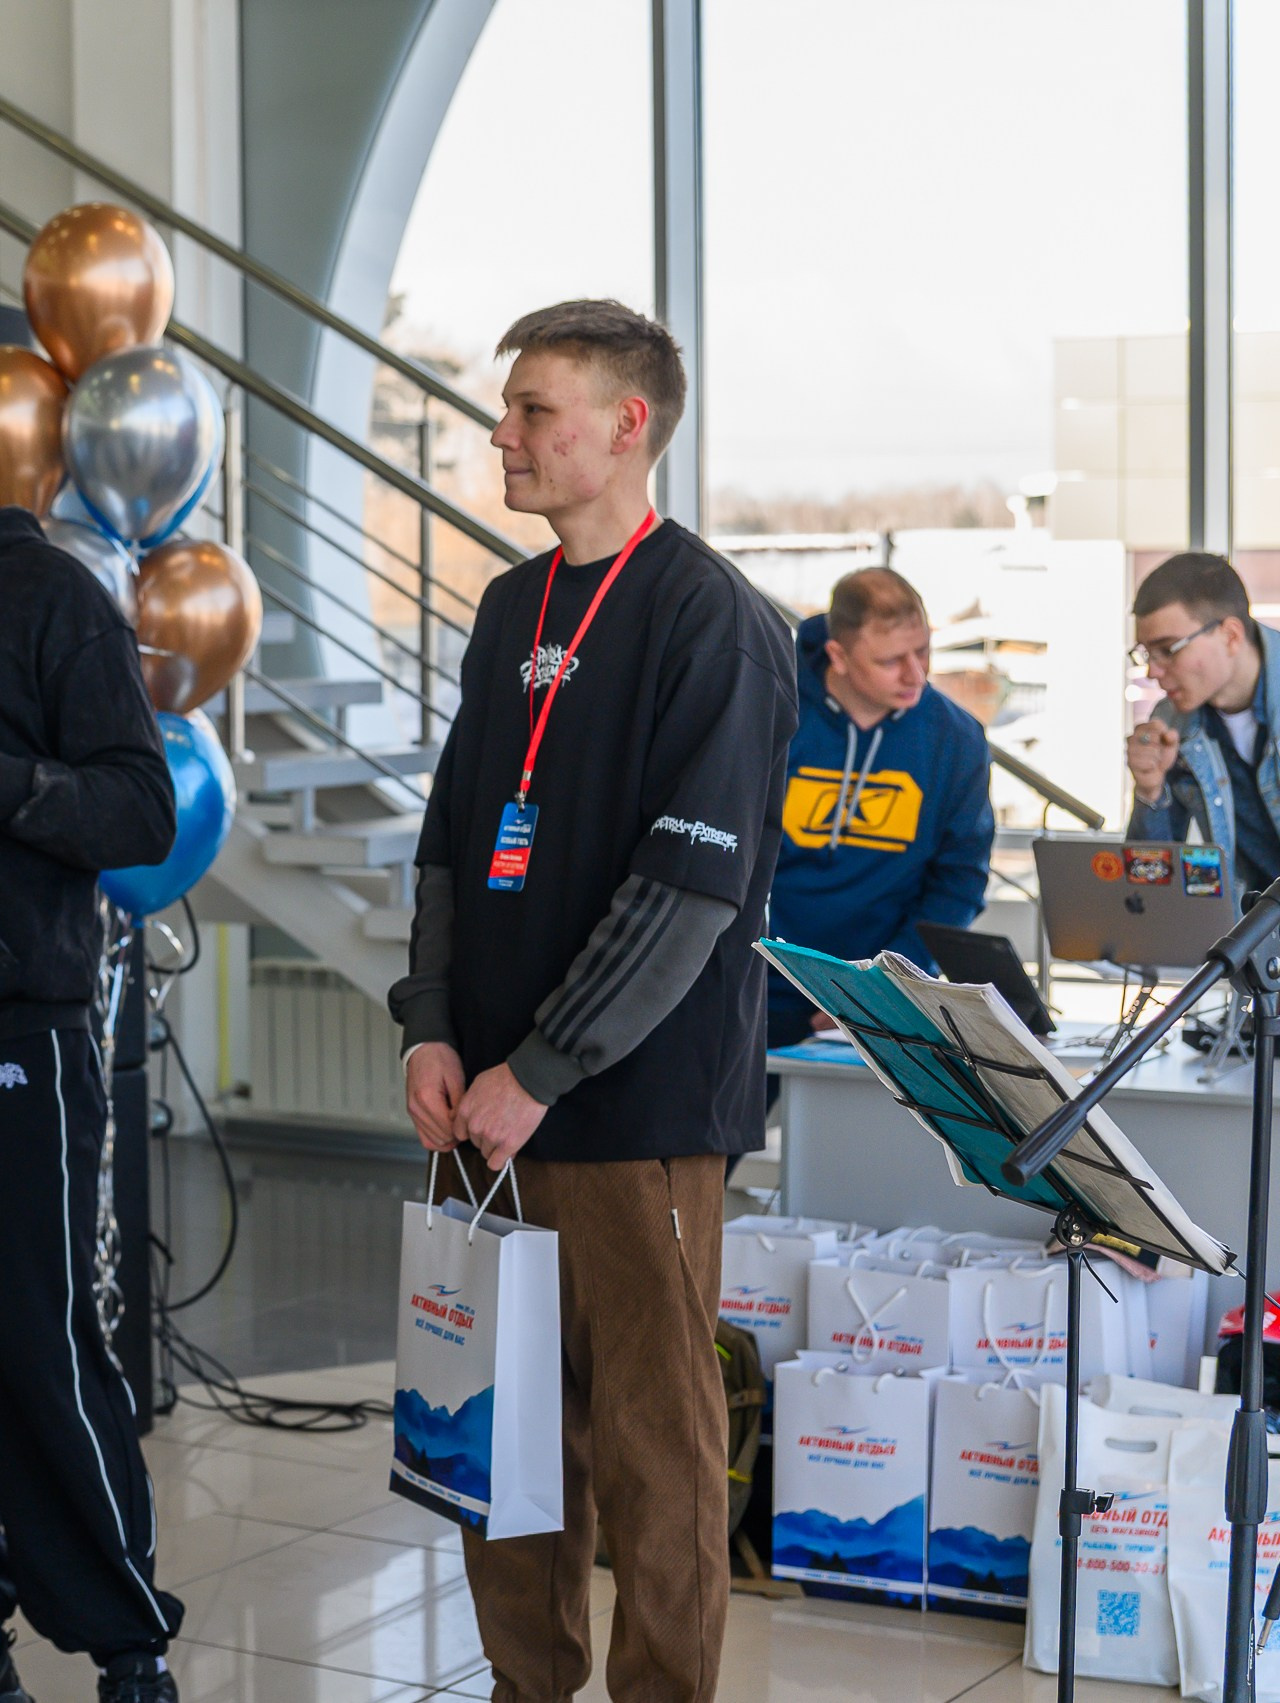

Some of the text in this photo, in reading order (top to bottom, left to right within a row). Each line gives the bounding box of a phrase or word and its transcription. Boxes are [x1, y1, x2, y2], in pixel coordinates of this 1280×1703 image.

[410, 1293, 448, 1319] АКТИВНЫЙ
[448, 1308, 474, 1330] ОТДЫХ
[721, 1300, 754, 1312] ИВНЫЙ
[887, 1340, 923, 1355] ОТДЫХ
[976, 1336, 1033, 1349] АКИВНЫЙ
[798, 1436, 897, 1456] АКТИВНЫЙ ОТДЫХ
[960, 1449, 1039, 1474] АКТИВНЫЙ ОТД
[1140, 1509, 1168, 1528] ОТД
